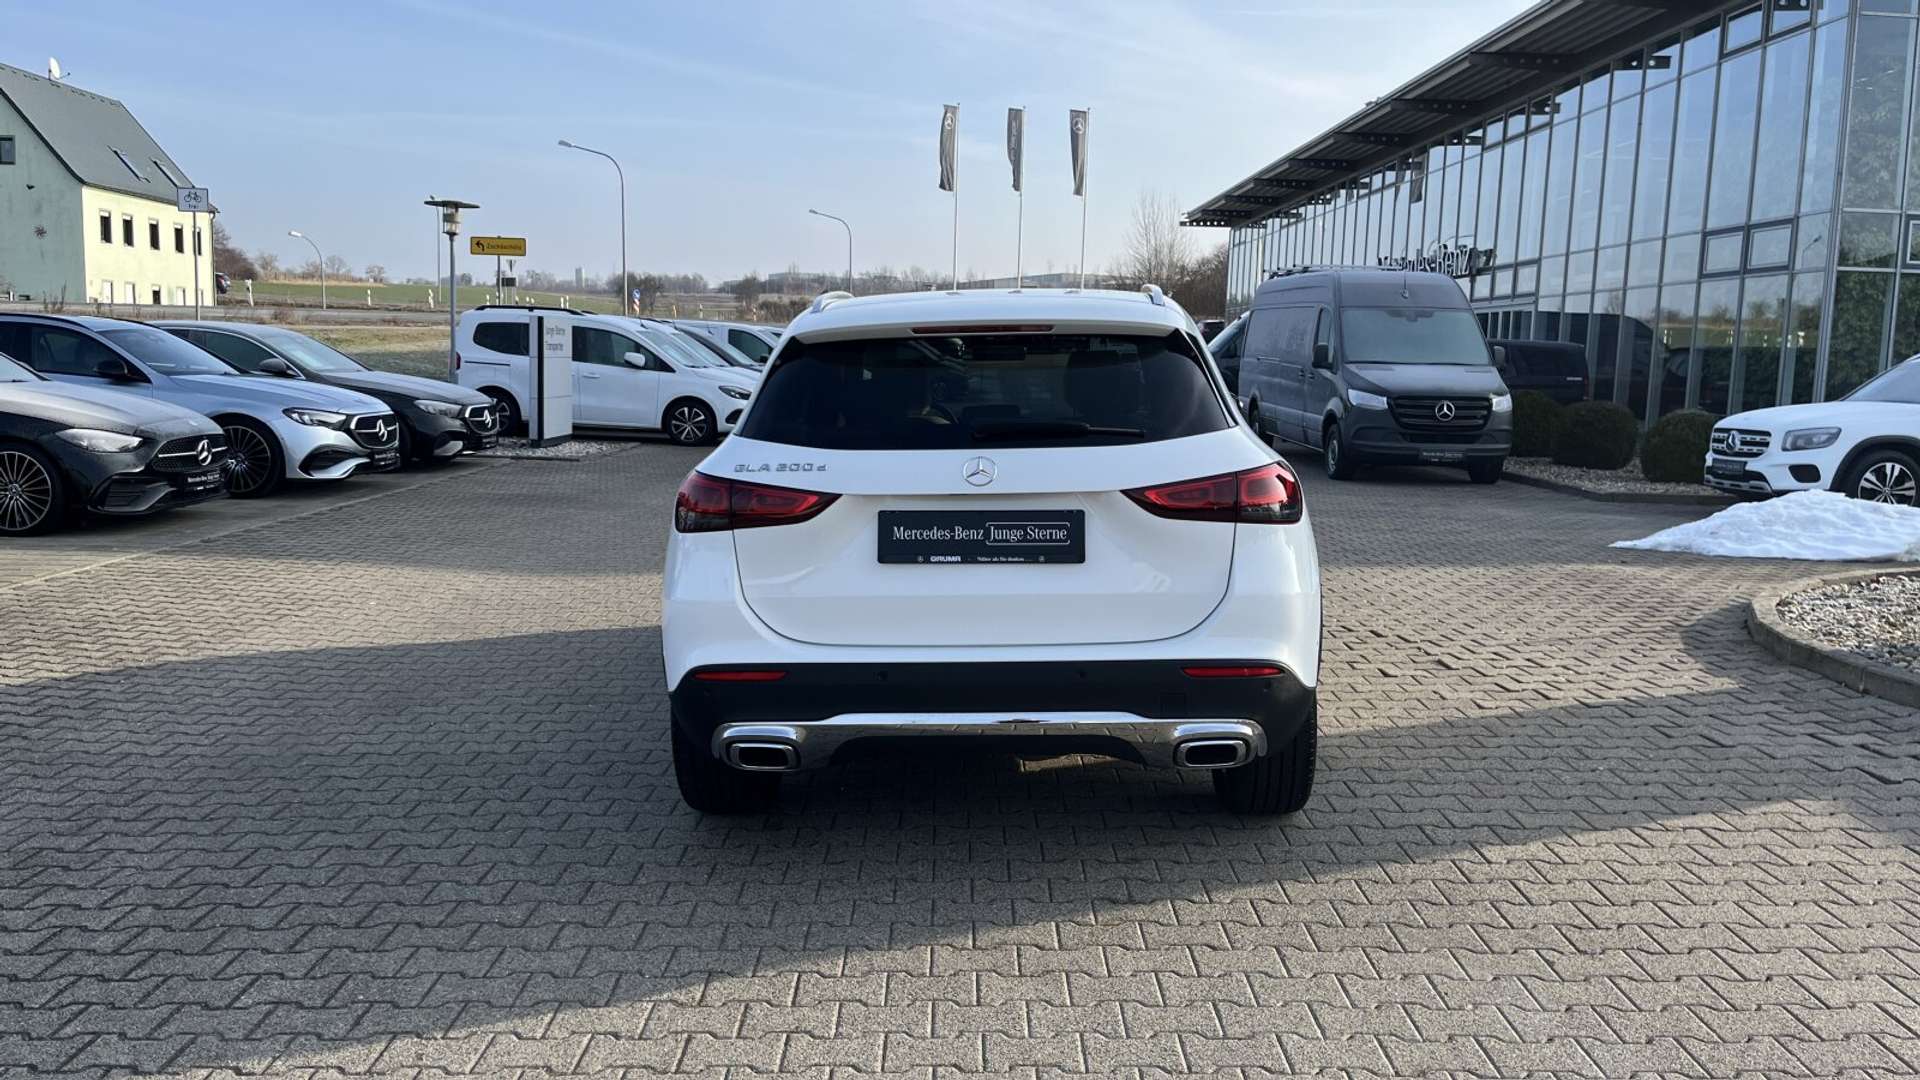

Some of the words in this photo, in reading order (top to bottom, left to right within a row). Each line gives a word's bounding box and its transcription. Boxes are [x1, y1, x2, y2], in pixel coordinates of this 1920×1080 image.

[734, 464, 770, 473] GLA
[892, 526, 984, 540] Mercedes-Benz
[989, 526, 1024, 542] Junge
[1026, 526, 1067, 540] Sterne
